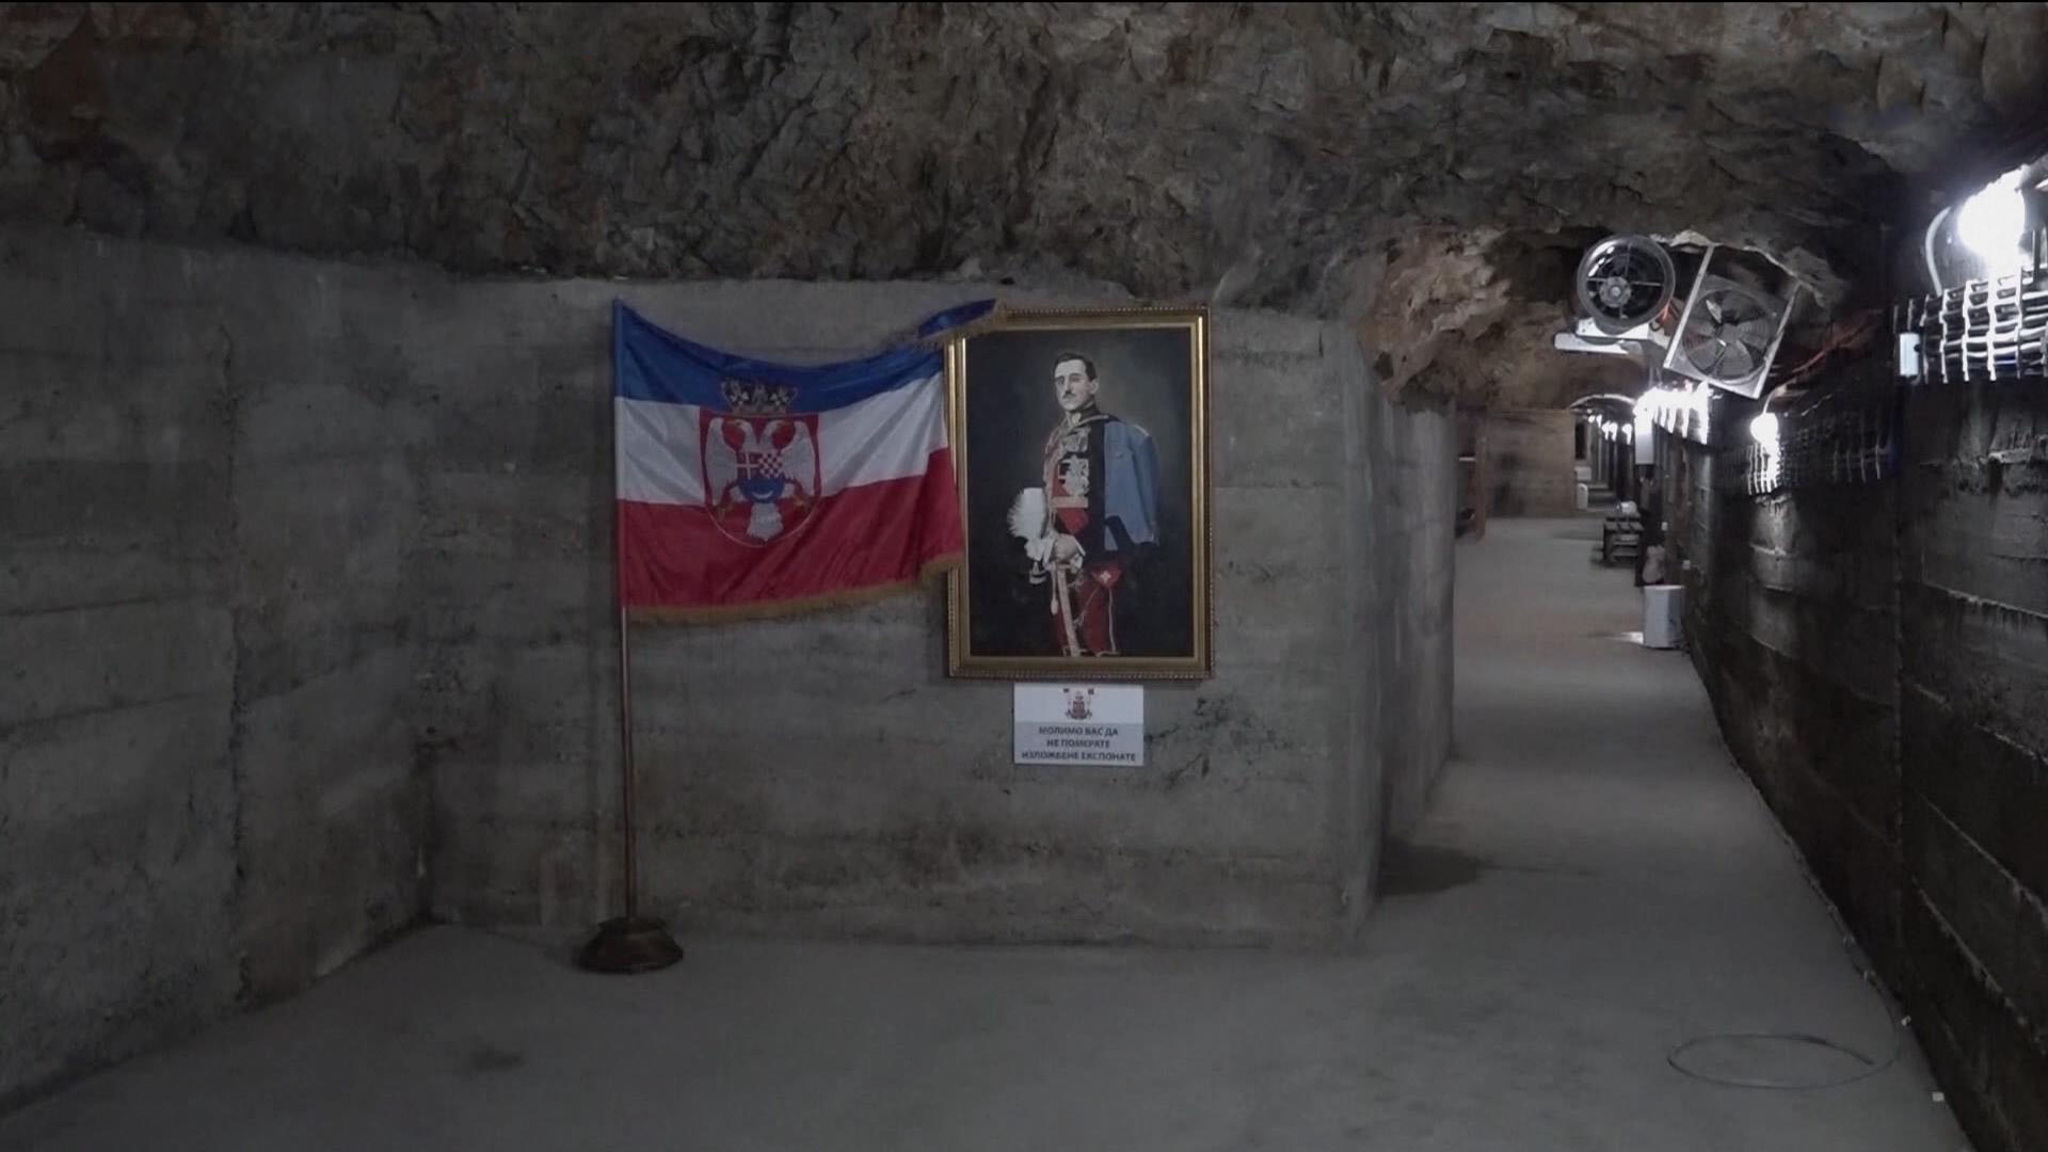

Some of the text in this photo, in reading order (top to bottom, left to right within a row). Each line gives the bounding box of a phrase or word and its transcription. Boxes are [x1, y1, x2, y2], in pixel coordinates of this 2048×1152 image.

[1085, 726, 1103, 736] ВАС
[1104, 727, 1119, 737] ДА
[1046, 738, 1059, 747] НЕ
[1081, 751, 1136, 761] ЕКСПОНАТЕ
